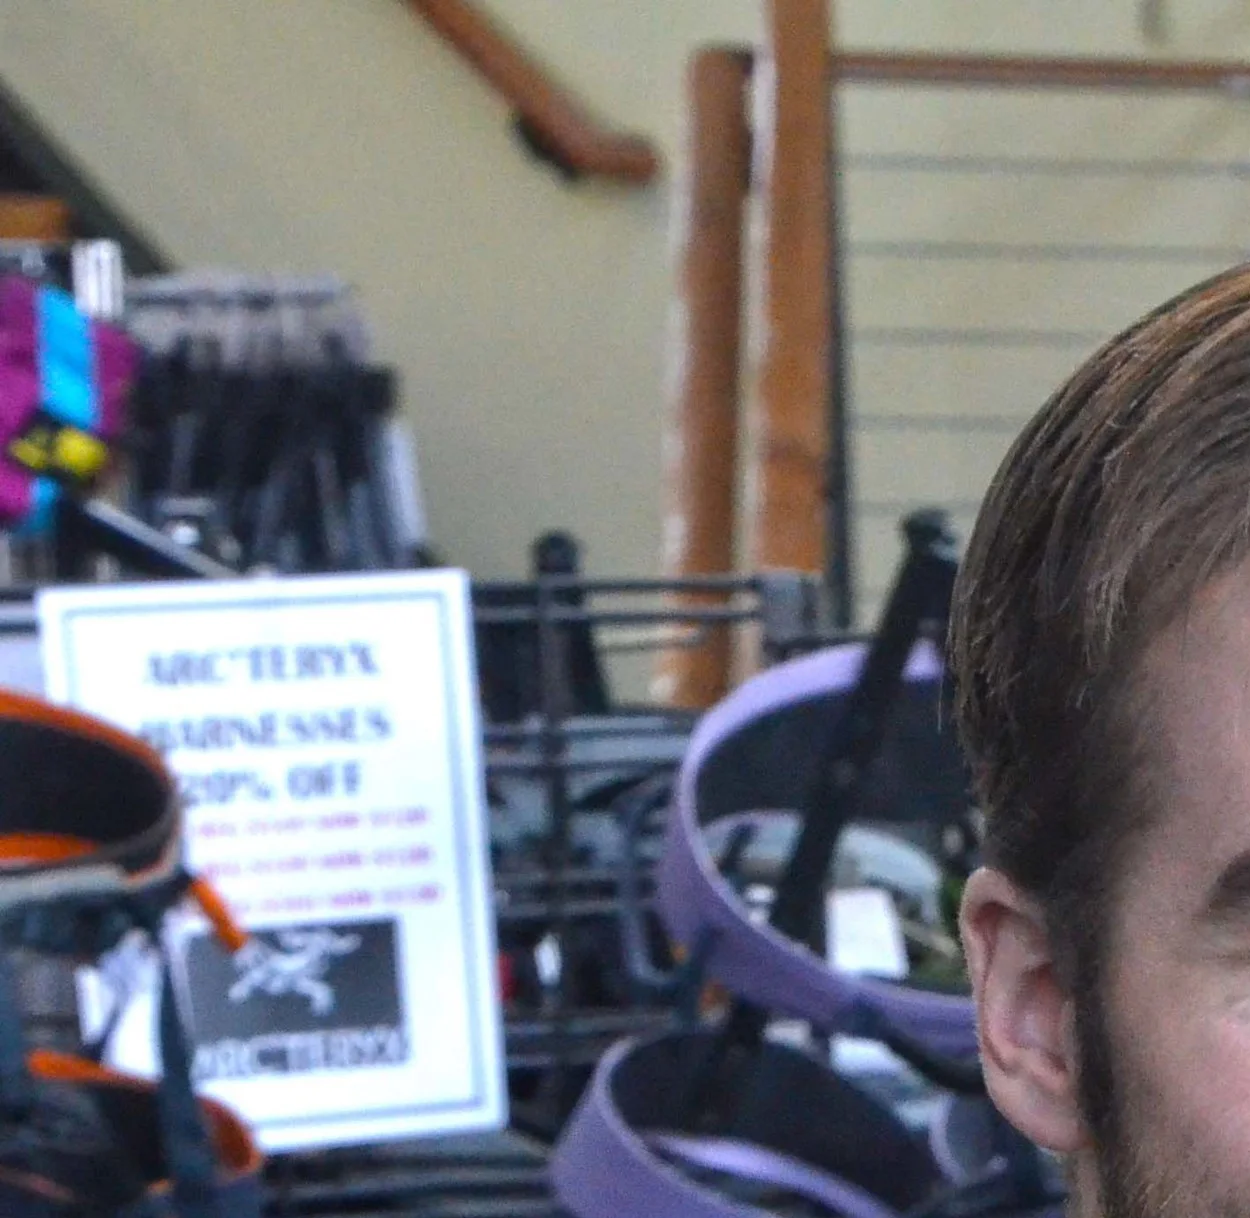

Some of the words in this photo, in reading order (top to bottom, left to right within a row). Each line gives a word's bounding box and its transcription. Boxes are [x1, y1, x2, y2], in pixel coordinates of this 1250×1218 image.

[146, 641, 380, 687] ARC'TERYX
[140, 708, 391, 751] HARNESSES
[286, 760, 361, 801] OFF
